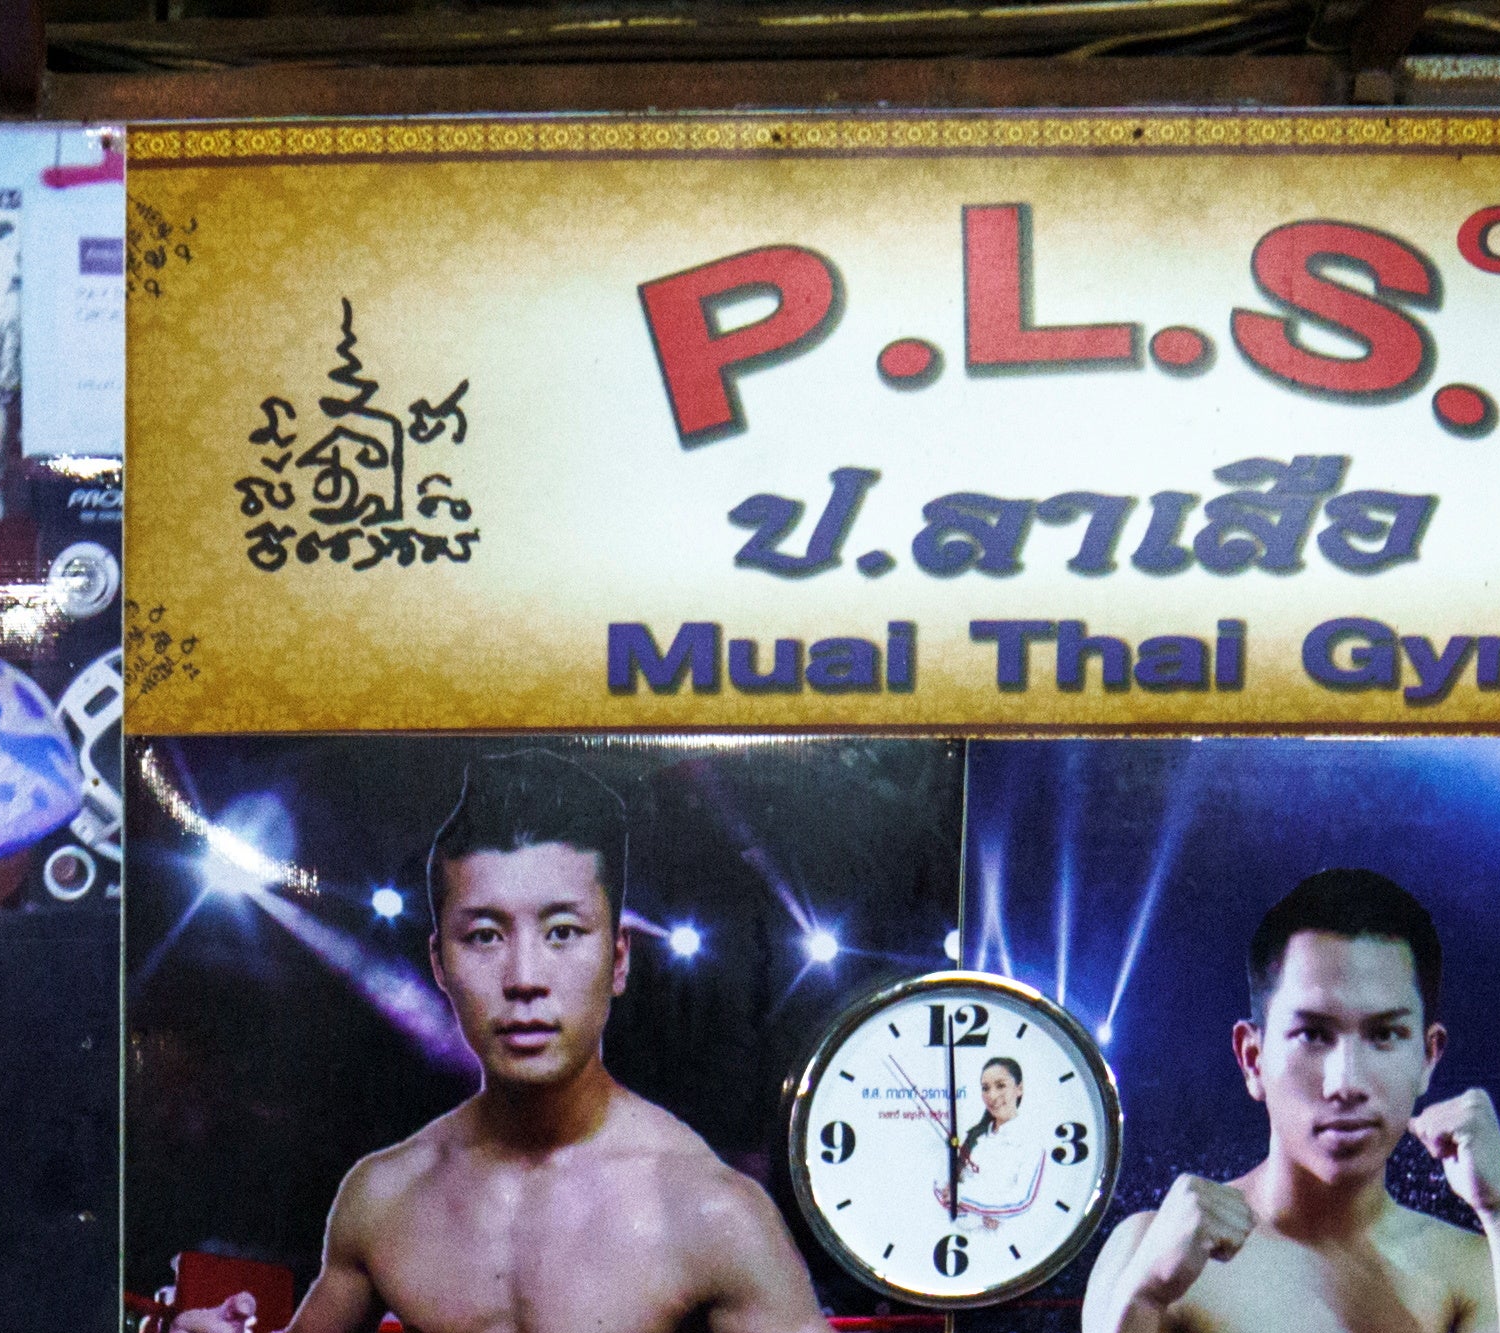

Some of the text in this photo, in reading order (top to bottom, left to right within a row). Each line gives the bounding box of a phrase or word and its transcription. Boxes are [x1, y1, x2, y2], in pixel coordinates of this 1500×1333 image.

[728, 454, 1440, 580] ป.ลาเสือ
[968, 620, 1247, 693] Thai
[924, 1003, 990, 1048] 12
[819, 1120, 857, 1165] 9
[1050, 1121, 1089, 1166] 3
[932, 1233, 970, 1278] 6
